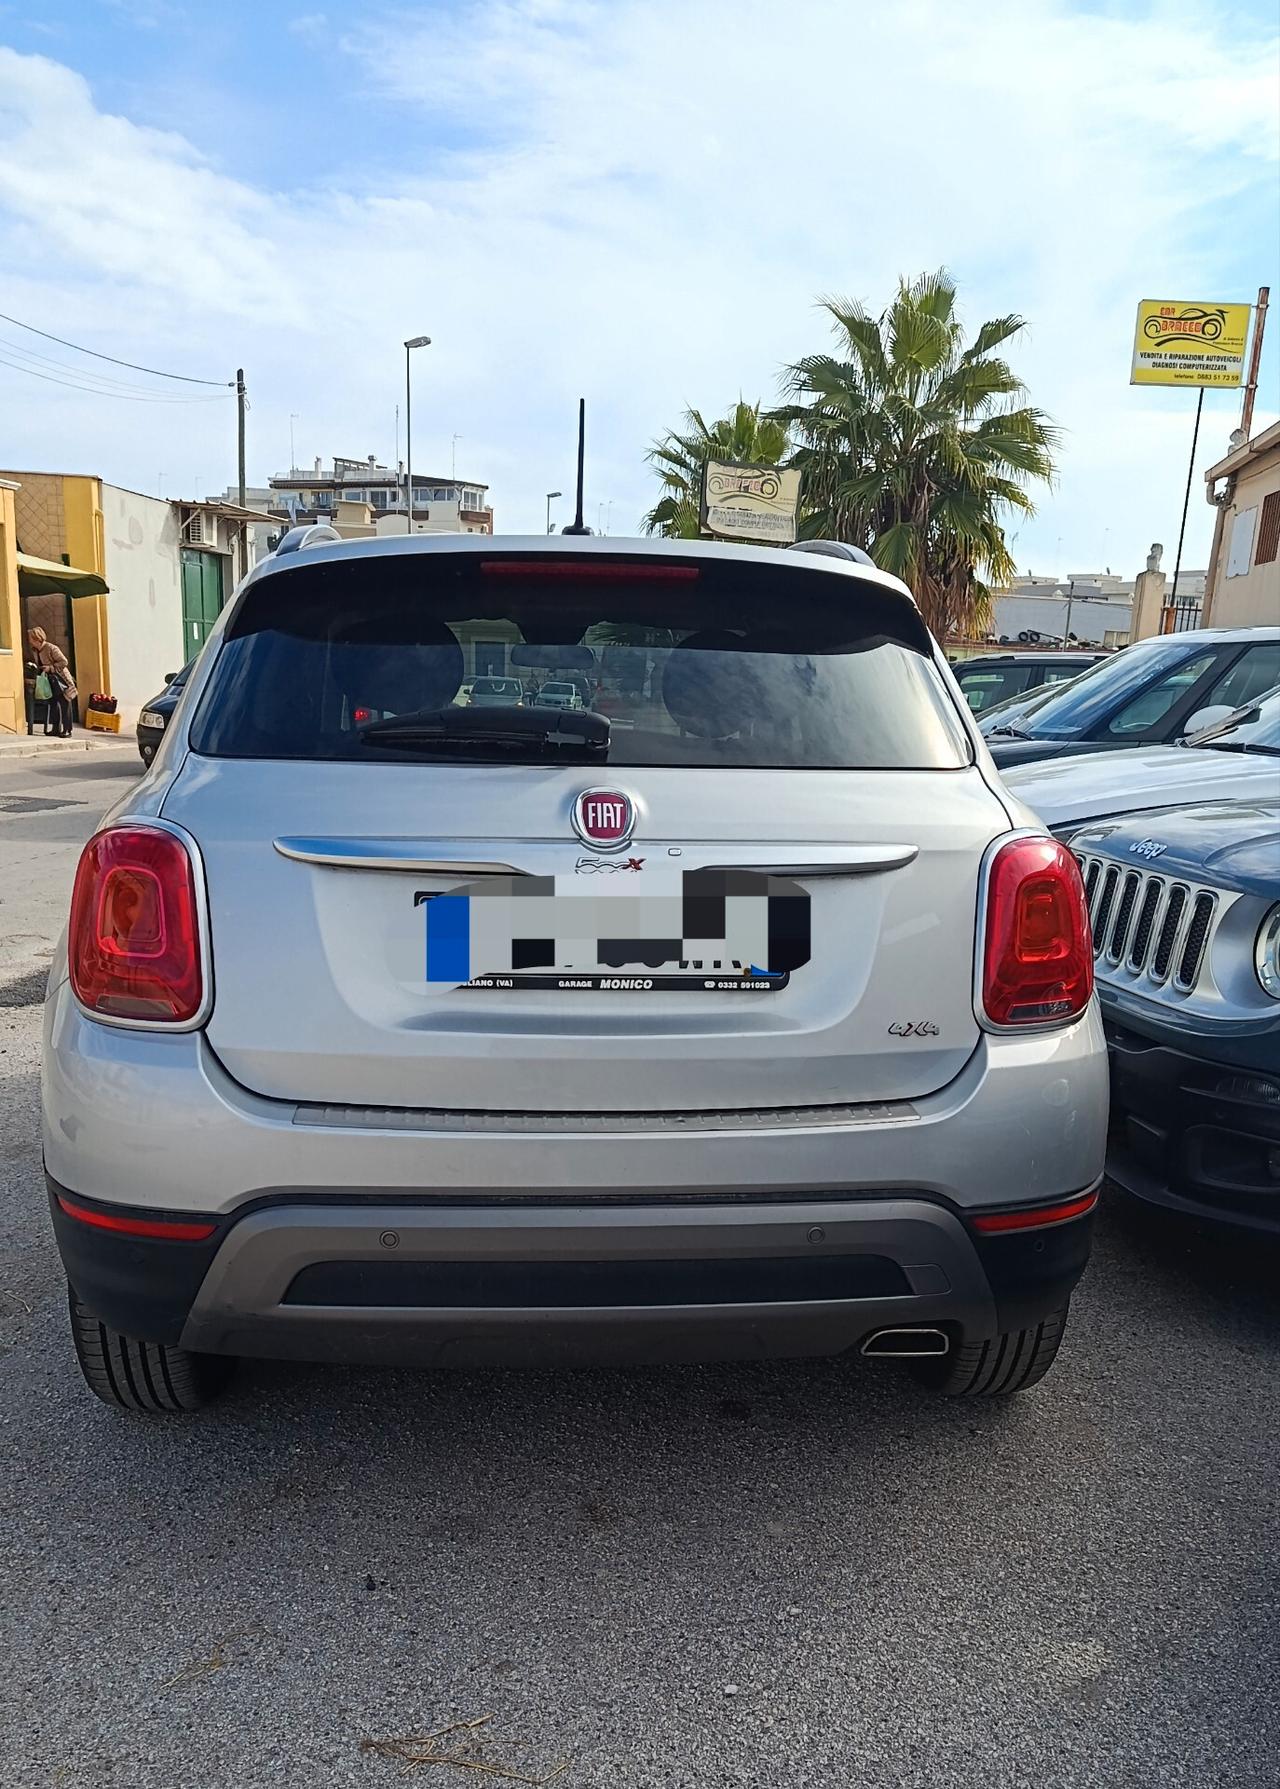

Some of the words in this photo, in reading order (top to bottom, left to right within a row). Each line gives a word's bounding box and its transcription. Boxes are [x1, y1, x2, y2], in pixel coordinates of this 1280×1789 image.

[1169, 353, 1204, 361] RIPARAZIONE
[1206, 355, 1242, 363] AUTOVEICOLI
[1152, 361, 1178, 369] DIAGNOSI
[1179, 362, 1227, 371] COMPUTERIZZATA
[587, 803, 624, 829] FIAT
[1129, 837, 1167, 860] Jeep
[496, 979, 513, 987] (VA)
[558, 980, 593, 988] GARAGE
[600, 979, 653, 989] MONICO
[718, 981, 738, 989] 0332
